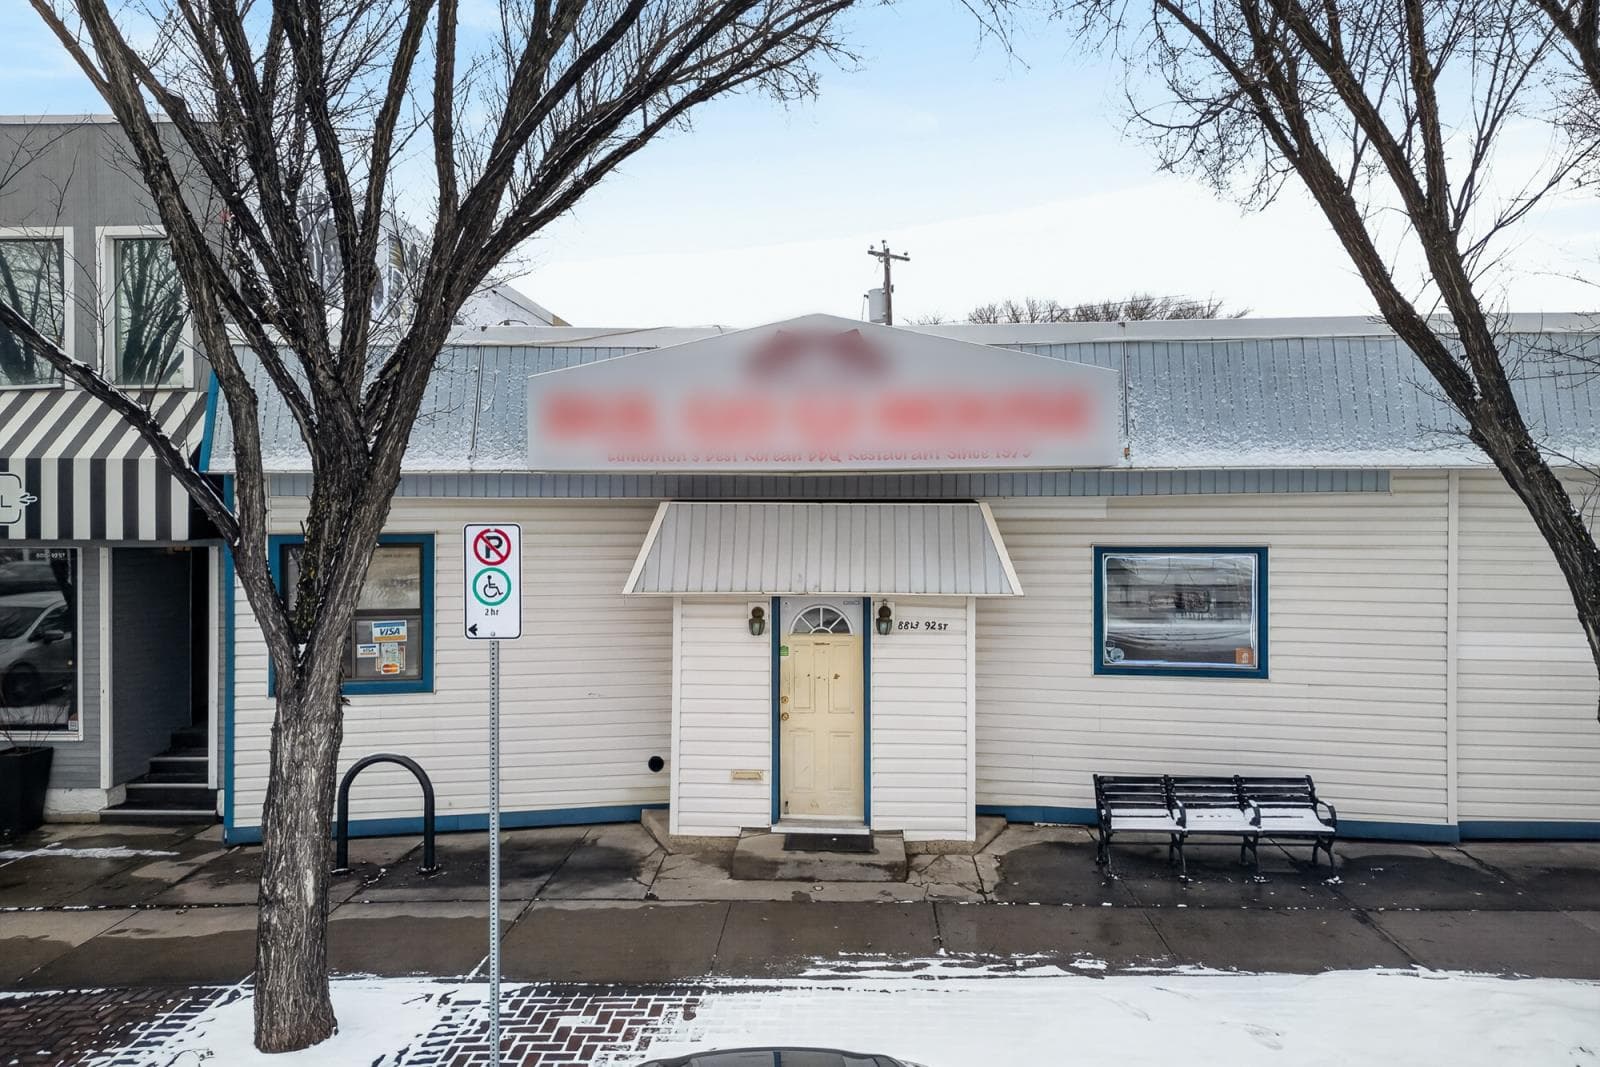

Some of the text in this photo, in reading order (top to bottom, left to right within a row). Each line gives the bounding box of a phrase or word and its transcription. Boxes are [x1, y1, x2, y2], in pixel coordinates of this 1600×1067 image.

[484, 608, 500, 617] 2 hr
[379, 627, 401, 637] VISA
